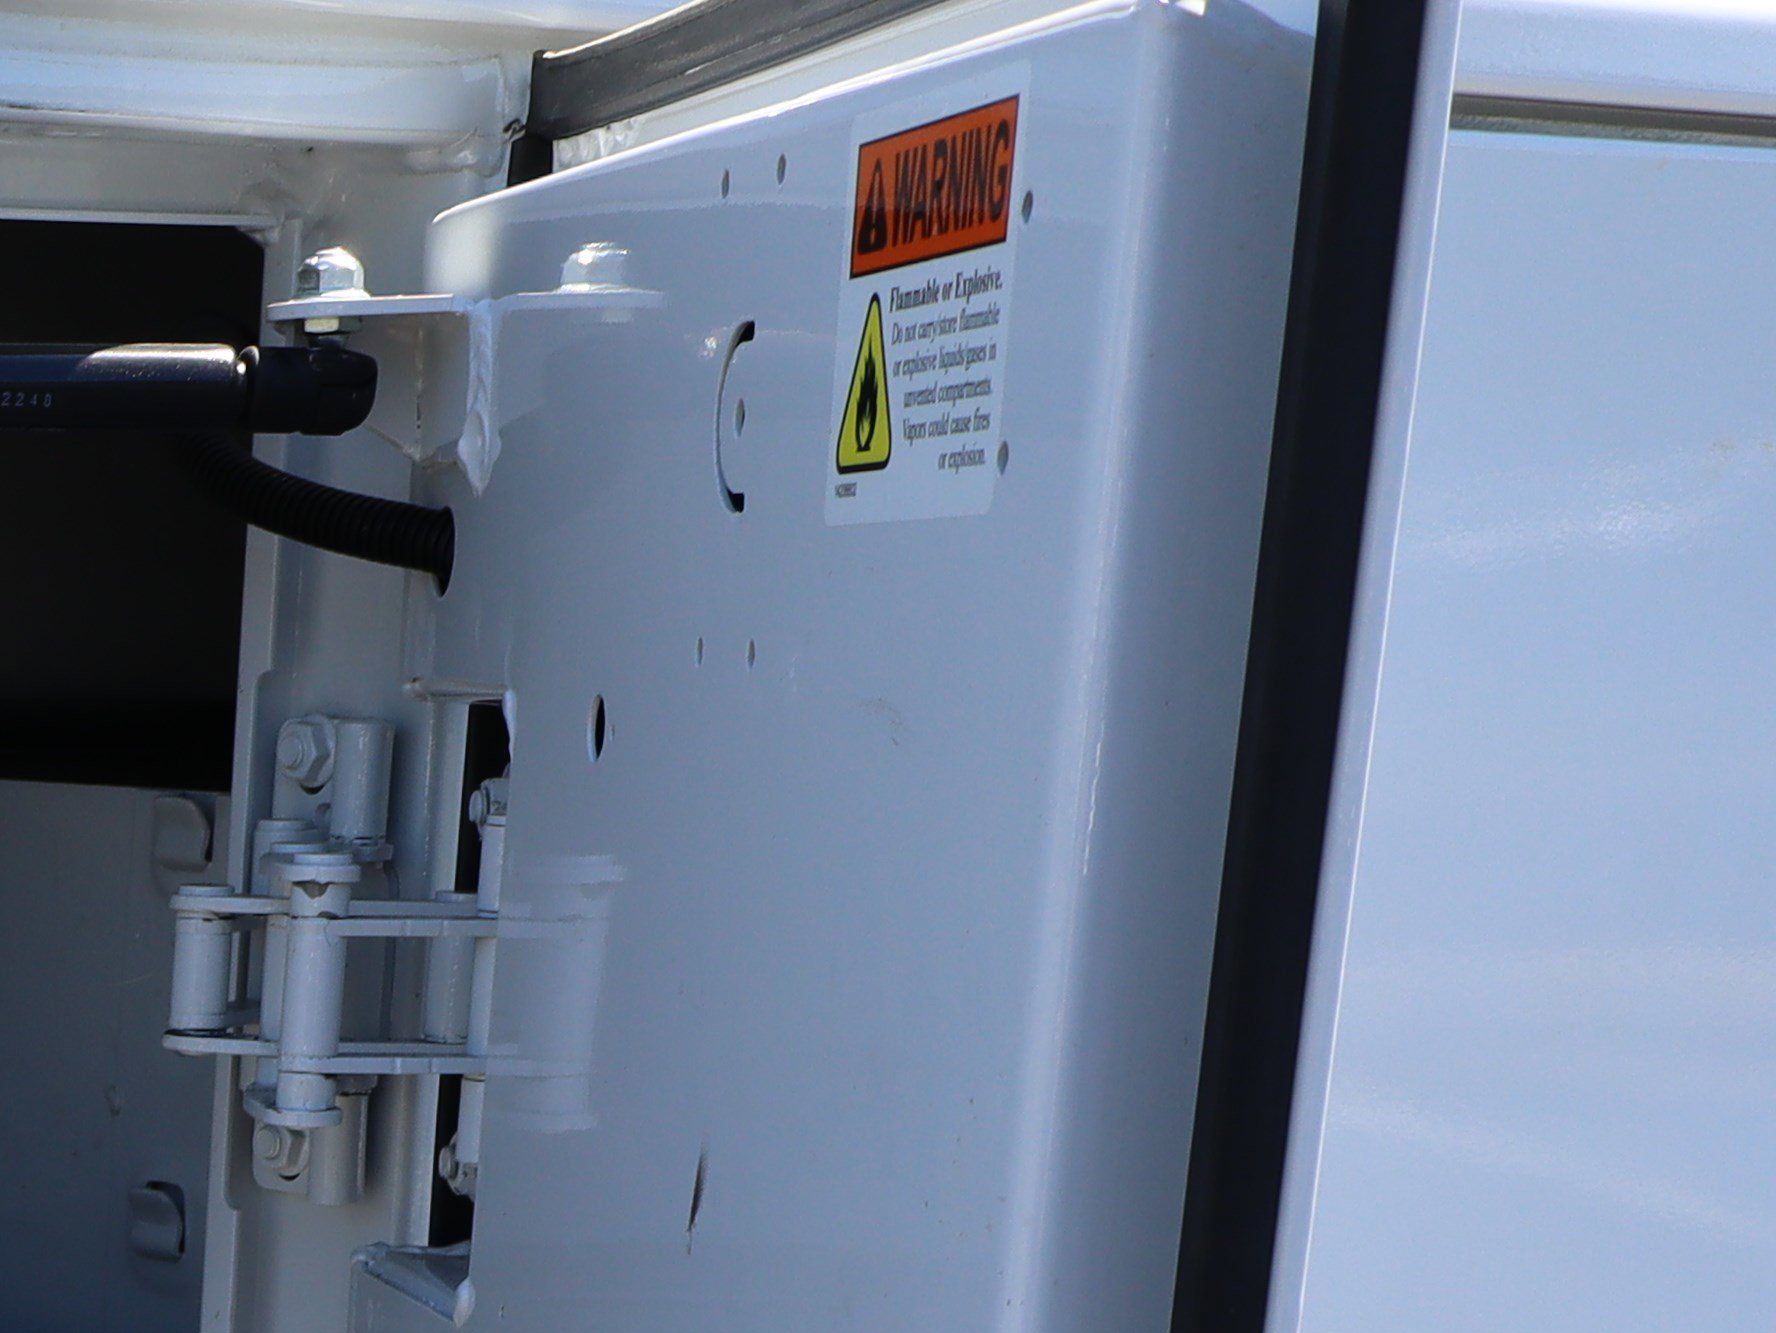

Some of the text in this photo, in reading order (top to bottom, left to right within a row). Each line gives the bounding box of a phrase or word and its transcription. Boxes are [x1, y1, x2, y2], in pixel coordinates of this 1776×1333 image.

[892, 117, 1010, 248] WARNING
[889, 278, 939, 314] Flammable
[941, 280, 953, 301] or
[891, 321, 903, 346] Do
[904, 323, 917, 342] not
